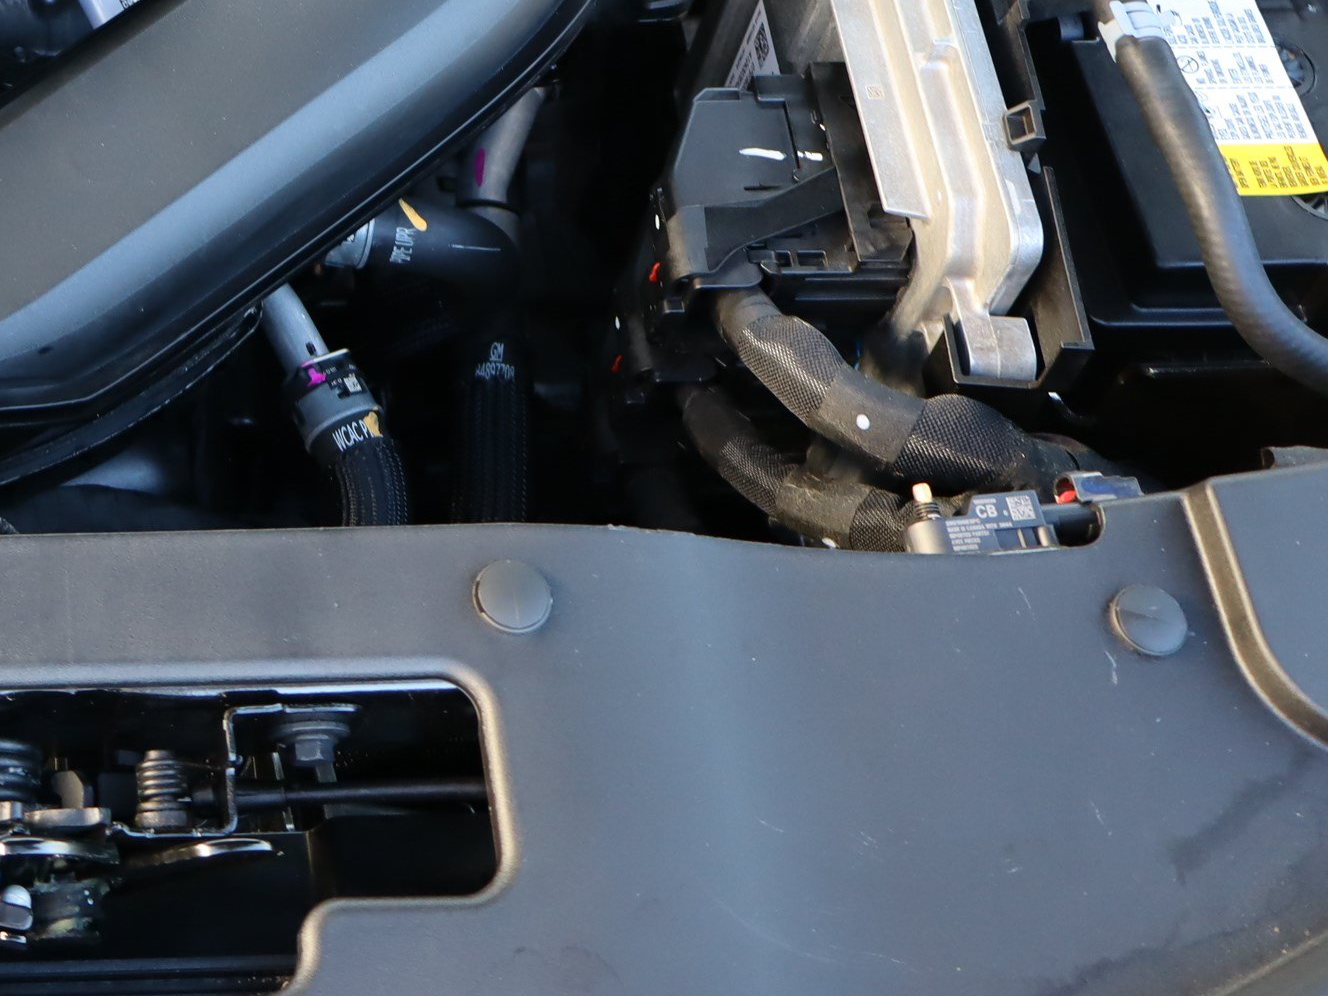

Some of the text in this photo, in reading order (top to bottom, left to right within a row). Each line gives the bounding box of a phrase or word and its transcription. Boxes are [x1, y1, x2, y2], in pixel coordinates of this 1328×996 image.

[489, 342, 505, 362] GM
[332, 420, 364, 452] WCAC
[975, 504, 998, 519] CB
